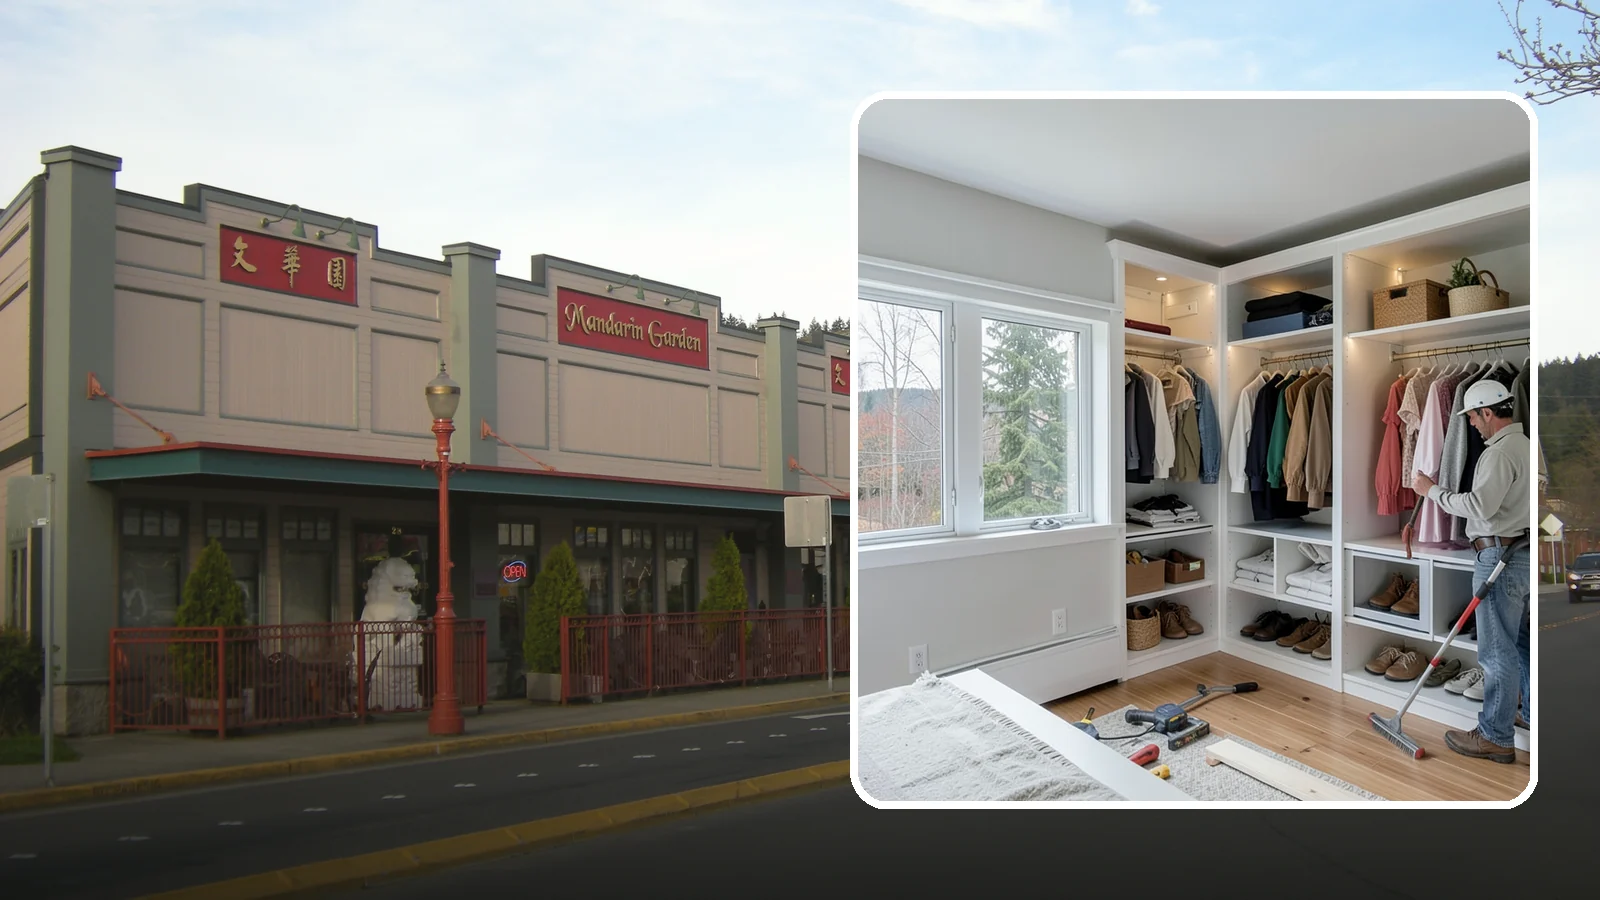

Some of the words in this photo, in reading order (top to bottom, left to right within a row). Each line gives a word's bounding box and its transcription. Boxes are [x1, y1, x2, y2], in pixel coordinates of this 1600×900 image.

[231, 236, 346, 291] 文華園
[564, 302, 644, 341] Mandarin
[648, 320, 701, 352] Garden
[503, 565, 527, 578] OPEN
